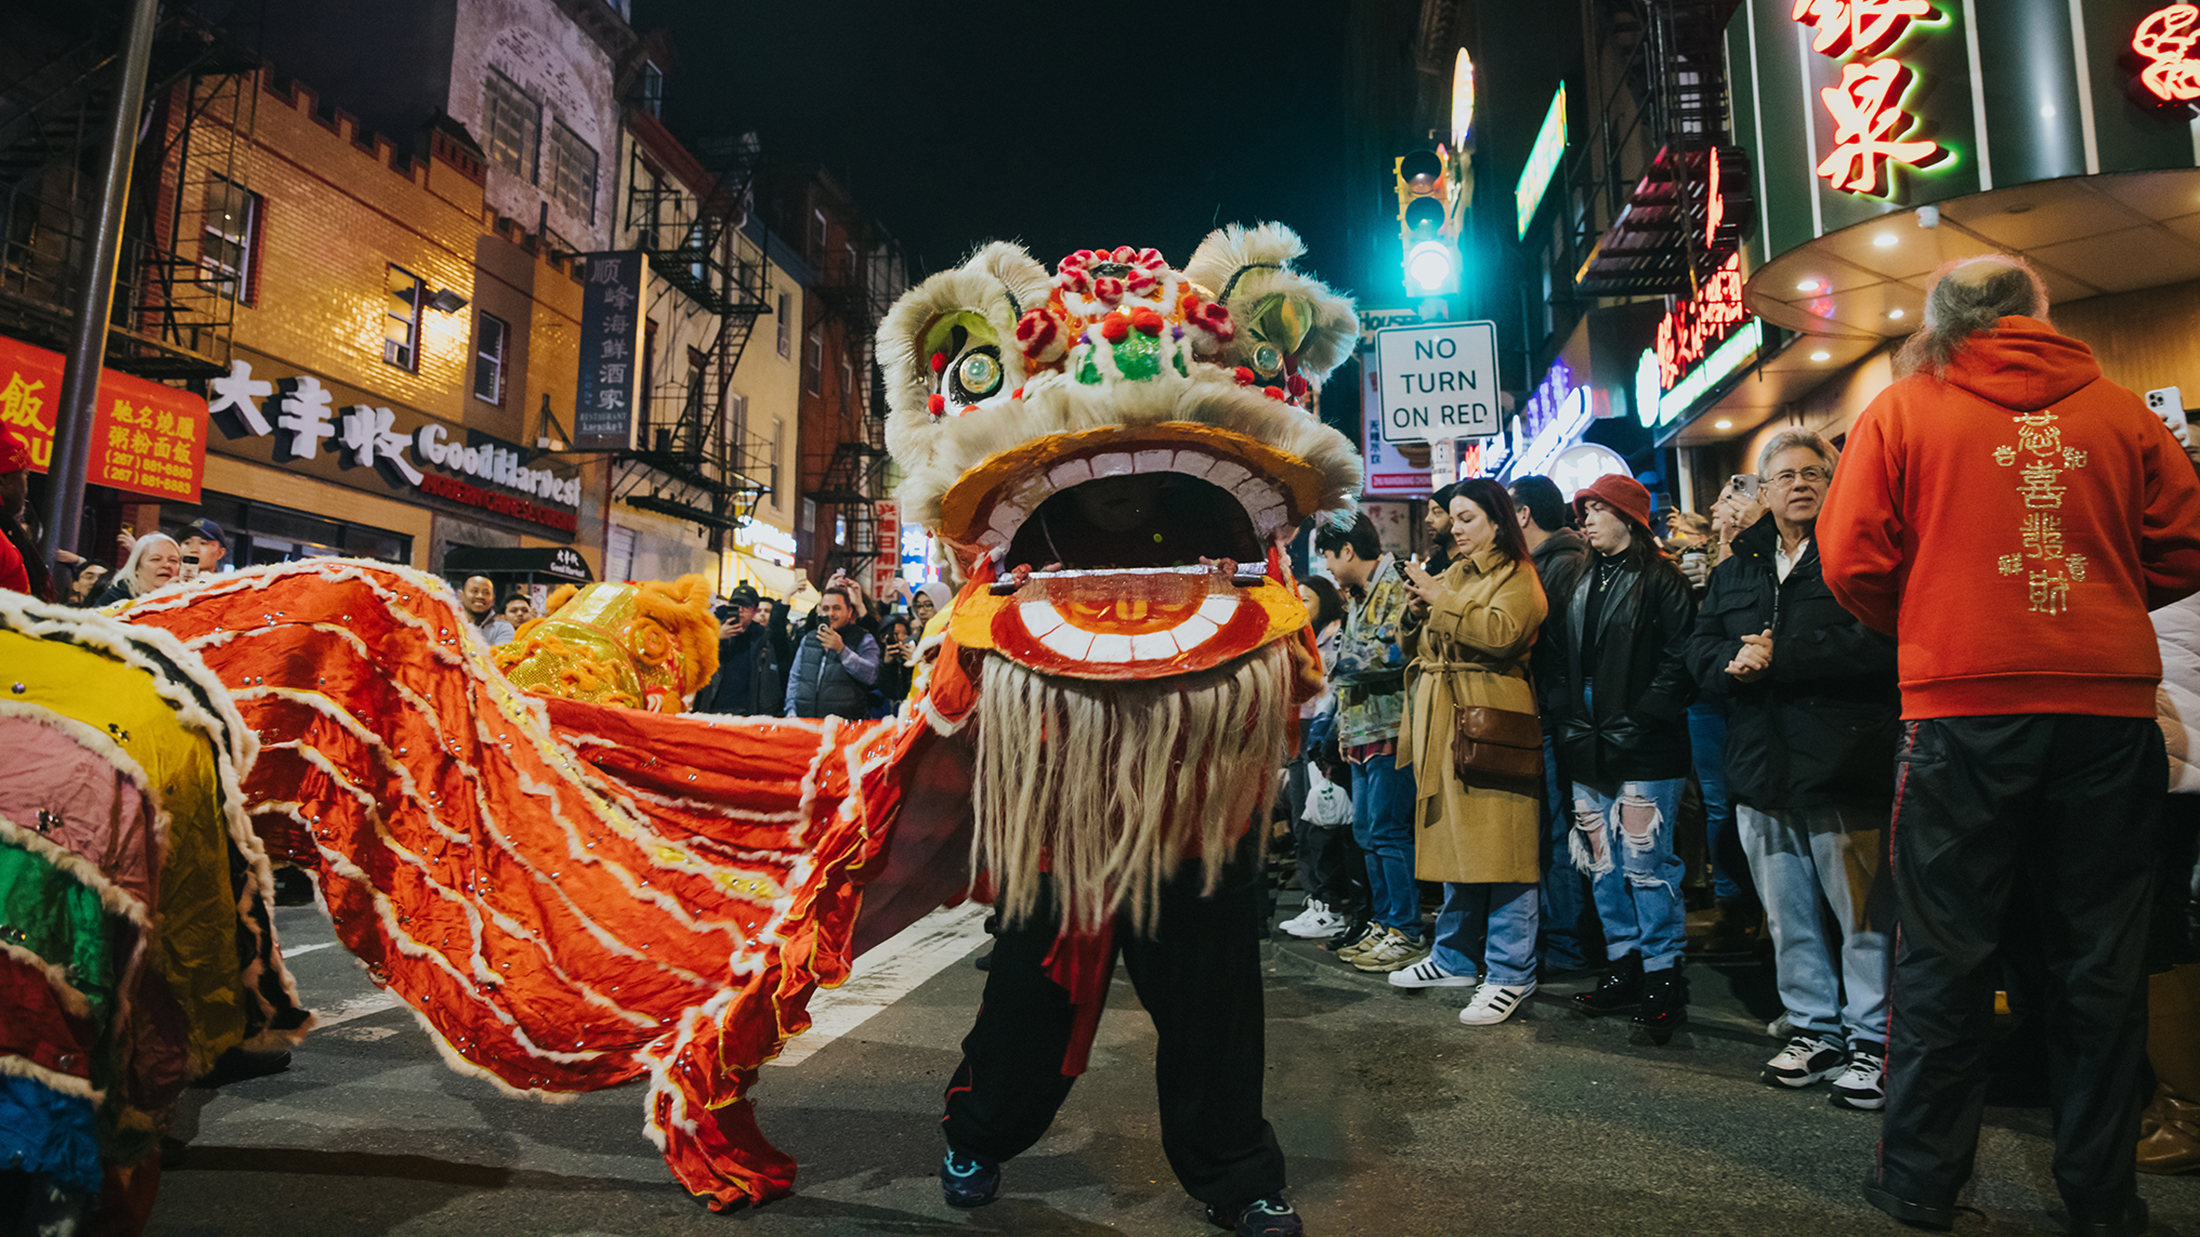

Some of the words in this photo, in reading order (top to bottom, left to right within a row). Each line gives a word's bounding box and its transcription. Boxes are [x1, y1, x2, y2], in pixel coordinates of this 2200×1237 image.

[1415, 338, 1457, 360] NO
[0, 371, 56, 437] 飯
[1400, 370, 1477, 394] TURN
[208, 359, 425, 487] 大丰收
[1393, 407, 1429, 428] ON
[1441, 403, 1487, 425] RED
[419, 423, 495, 481] Good
[493, 447, 582, 508] Harvest
